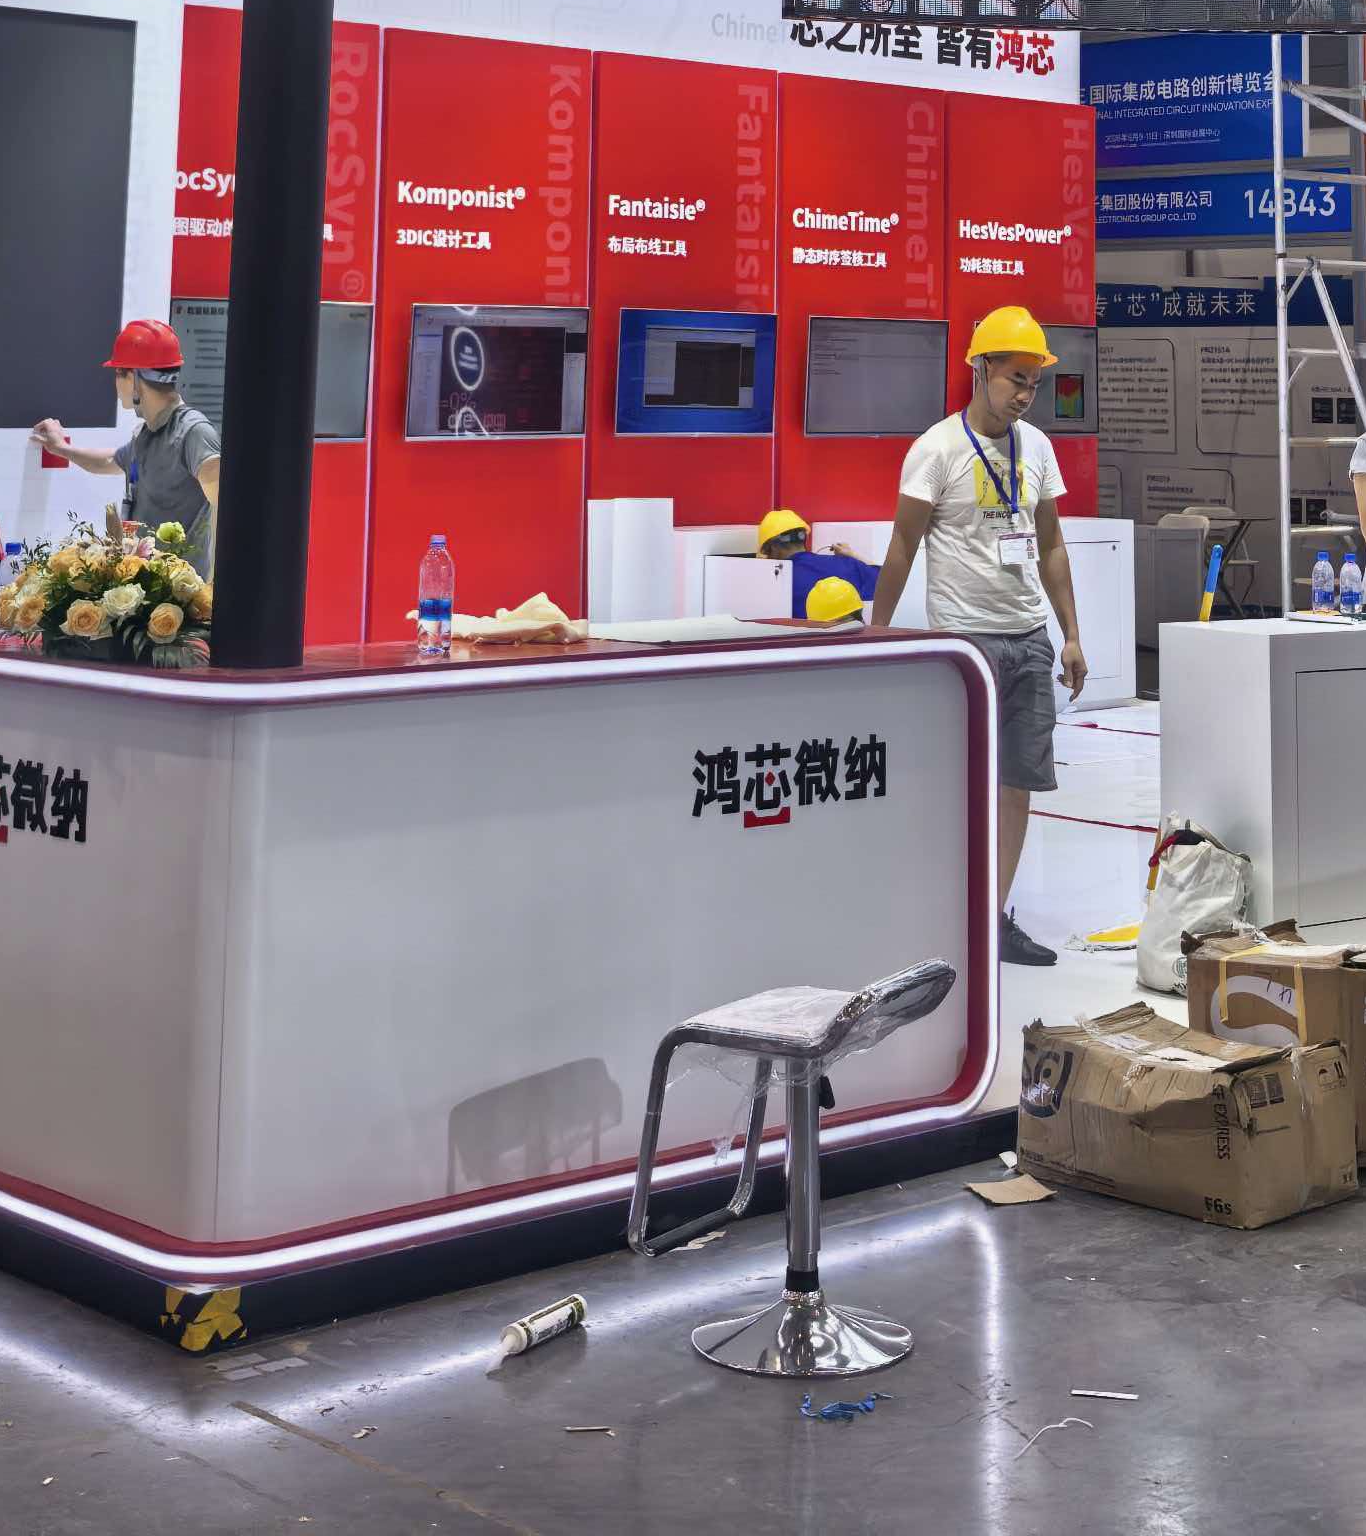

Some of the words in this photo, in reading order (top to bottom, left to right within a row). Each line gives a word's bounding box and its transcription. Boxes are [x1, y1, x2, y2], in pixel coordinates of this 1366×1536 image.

[936, 24, 1055, 76] 皆有鸿芯
[1089, 70, 1276, 105] 国际集成电路创新博览会
[1114, 106, 1165, 119] INTEGRATED
[1166, 103, 1201, 116] CIRCUIT
[1202, 99, 1255, 113] INNOVATION
[1256, 98, 1274, 110] EXP
[174, 167, 235, 198] ocSy
[539, 64, 583, 306] Komponi
[735, 84, 769, 314] Fantaisi
[906, 101, 939, 311] ChimeTi
[1063, 117, 1092, 323] HesVesP
[1094, 214, 1139, 225] LECTRONICS
[396, 228, 492, 251] 3DIC设计工具
[608, 236, 687, 258] 布局布线工具
[792, 247, 887, 269] 静态时序签核工具
[959, 258, 1024, 277] 功耗签核工具
[692, 734, 889, 827] 鸿芯微纳
